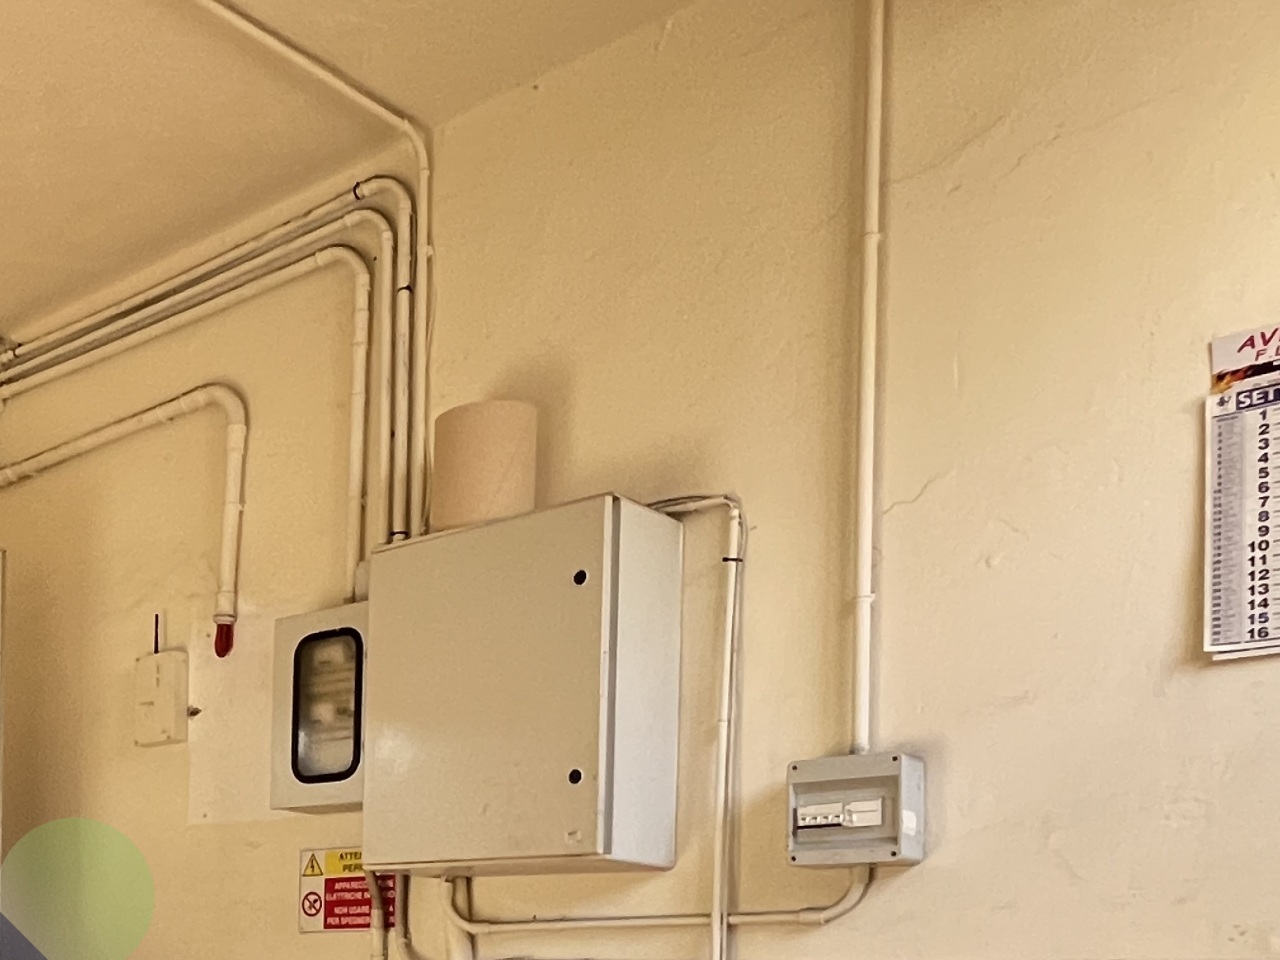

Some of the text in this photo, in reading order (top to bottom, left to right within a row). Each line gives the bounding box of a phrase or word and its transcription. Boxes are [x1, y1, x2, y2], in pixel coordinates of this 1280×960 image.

[1236, 327, 1280, 354] AV
[1238, 386, 1280, 408] SET
[1259, 409, 1268, 421] 1
[1258, 423, 1270, 436] 2
[1258, 438, 1270, 450] 3
[1257, 452, 1270, 464] 4
[1258, 467, 1270, 479] 5
[1257, 481, 1270, 494] 6
[1258, 495, 1270, 508] 7
[1257, 510, 1270, 523] 8
[1257, 525, 1270, 537] 9
[1247, 539, 1270, 553] 10
[1247, 554, 1267, 567] 11
[1247, 568, 1270, 582] 12
[1247, 583, 1270, 596] 13
[1247, 597, 1270, 611] 14
[1247, 612, 1270, 625] 15
[1247, 626, 1270, 639] 16
[339, 851, 362, 861] ATTE
